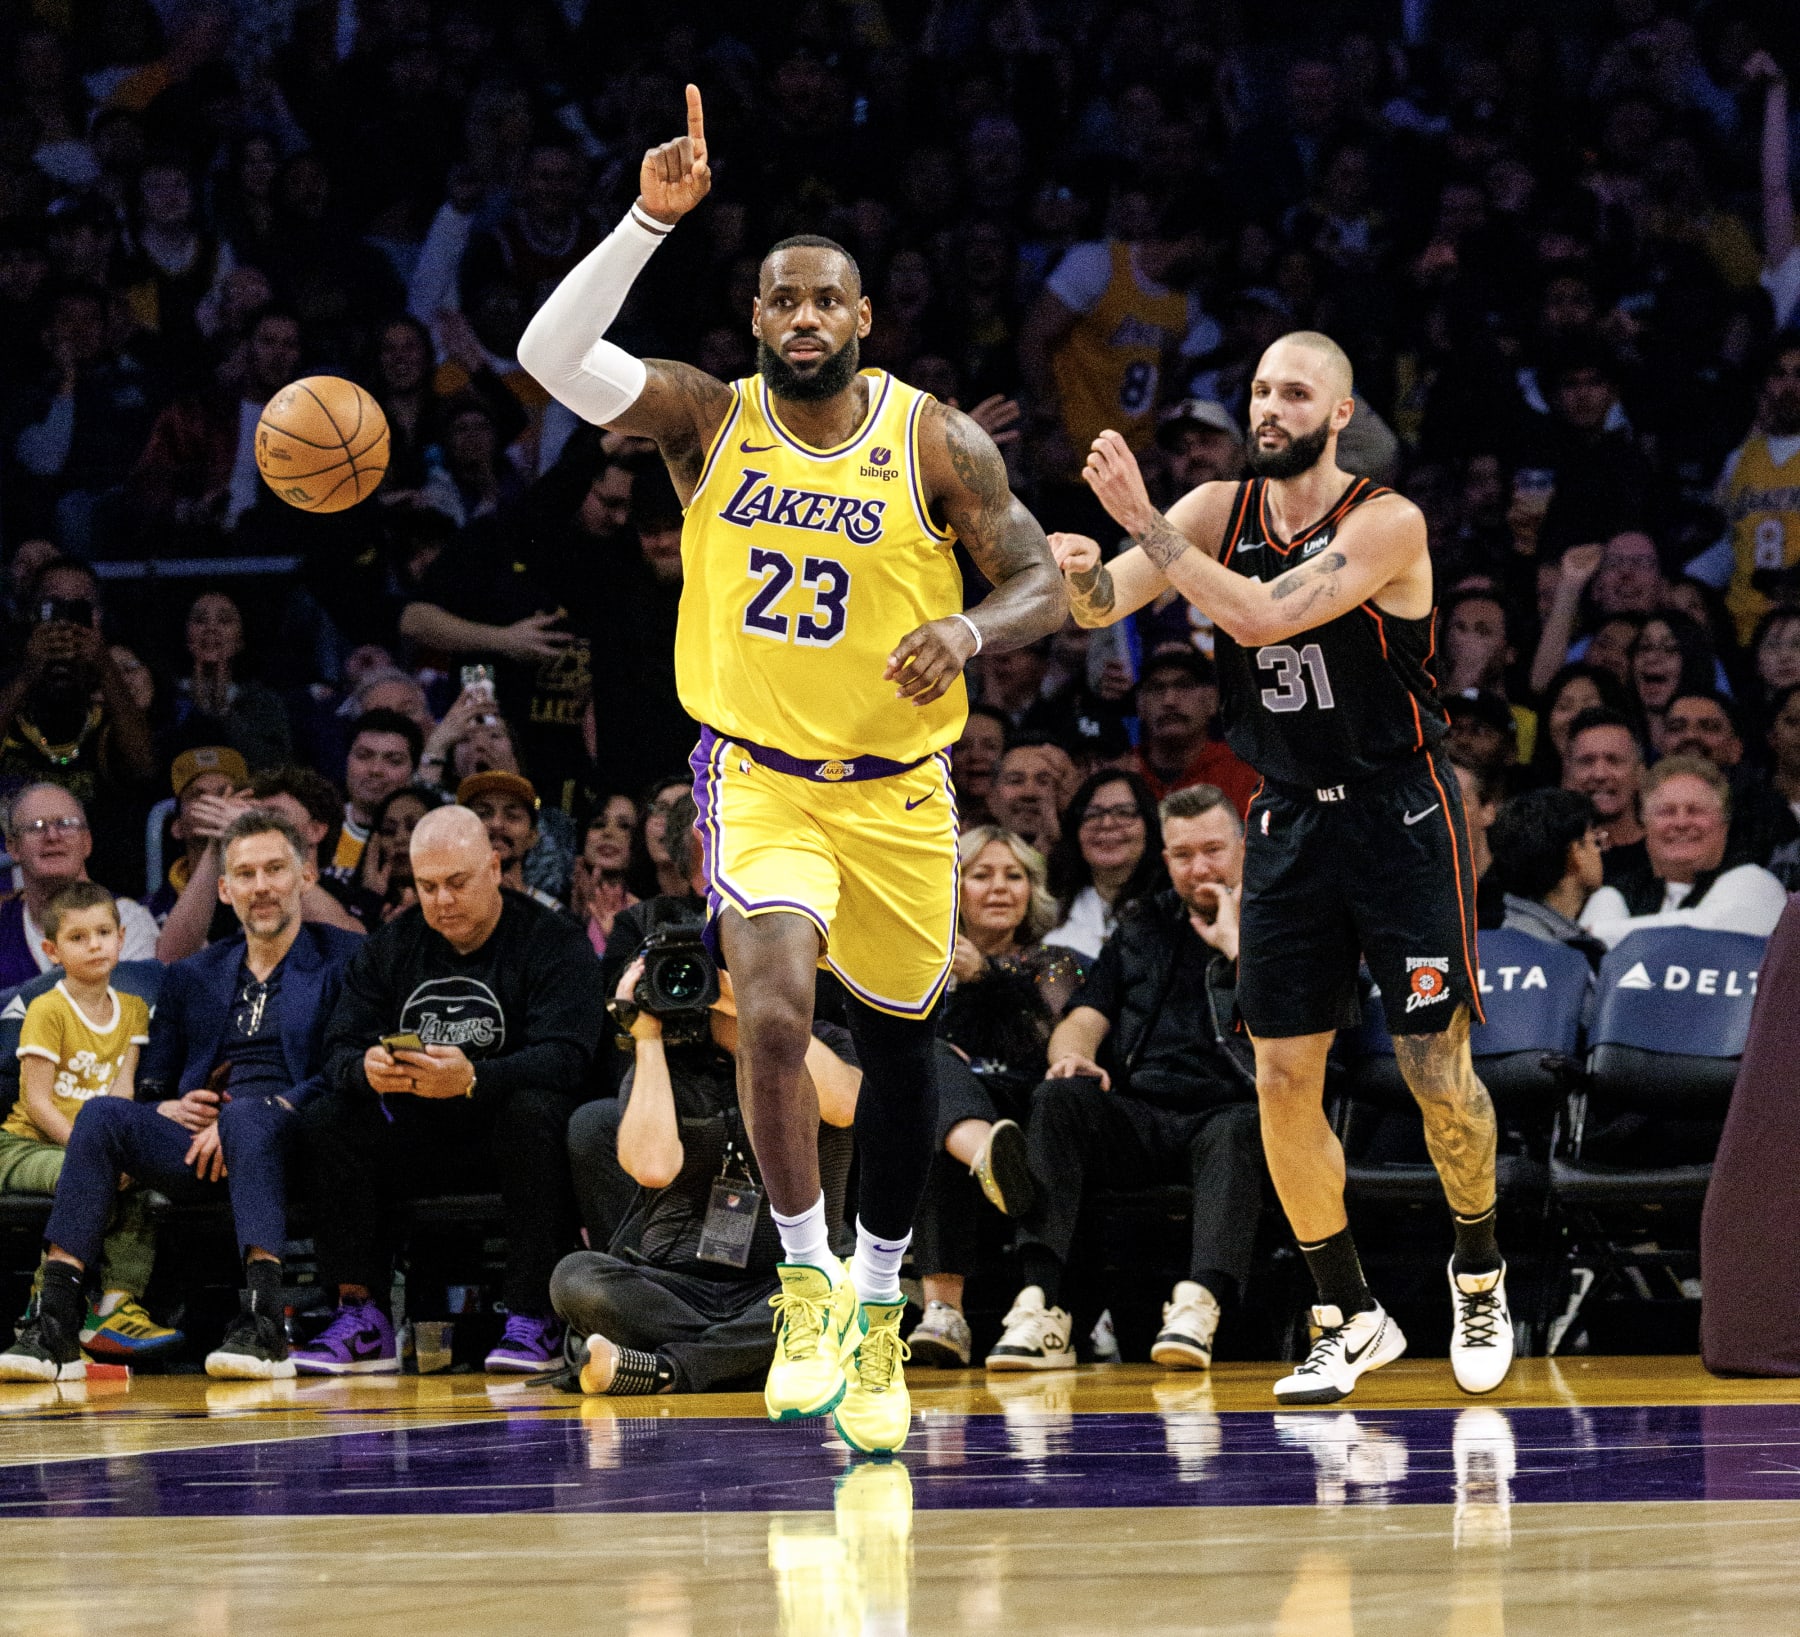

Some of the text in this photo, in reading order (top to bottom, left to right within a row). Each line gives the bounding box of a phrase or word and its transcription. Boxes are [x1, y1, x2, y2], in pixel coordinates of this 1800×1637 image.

[860, 466, 899, 481] bibigo
[719, 468, 888, 546] LAKERS
[1755, 519, 1785, 570] 8
[743, 546, 852, 648] 23
[1256, 643, 1336, 712] 31
[1479, 966, 1548, 993] LTA
[1663, 965, 1758, 998] DELT
